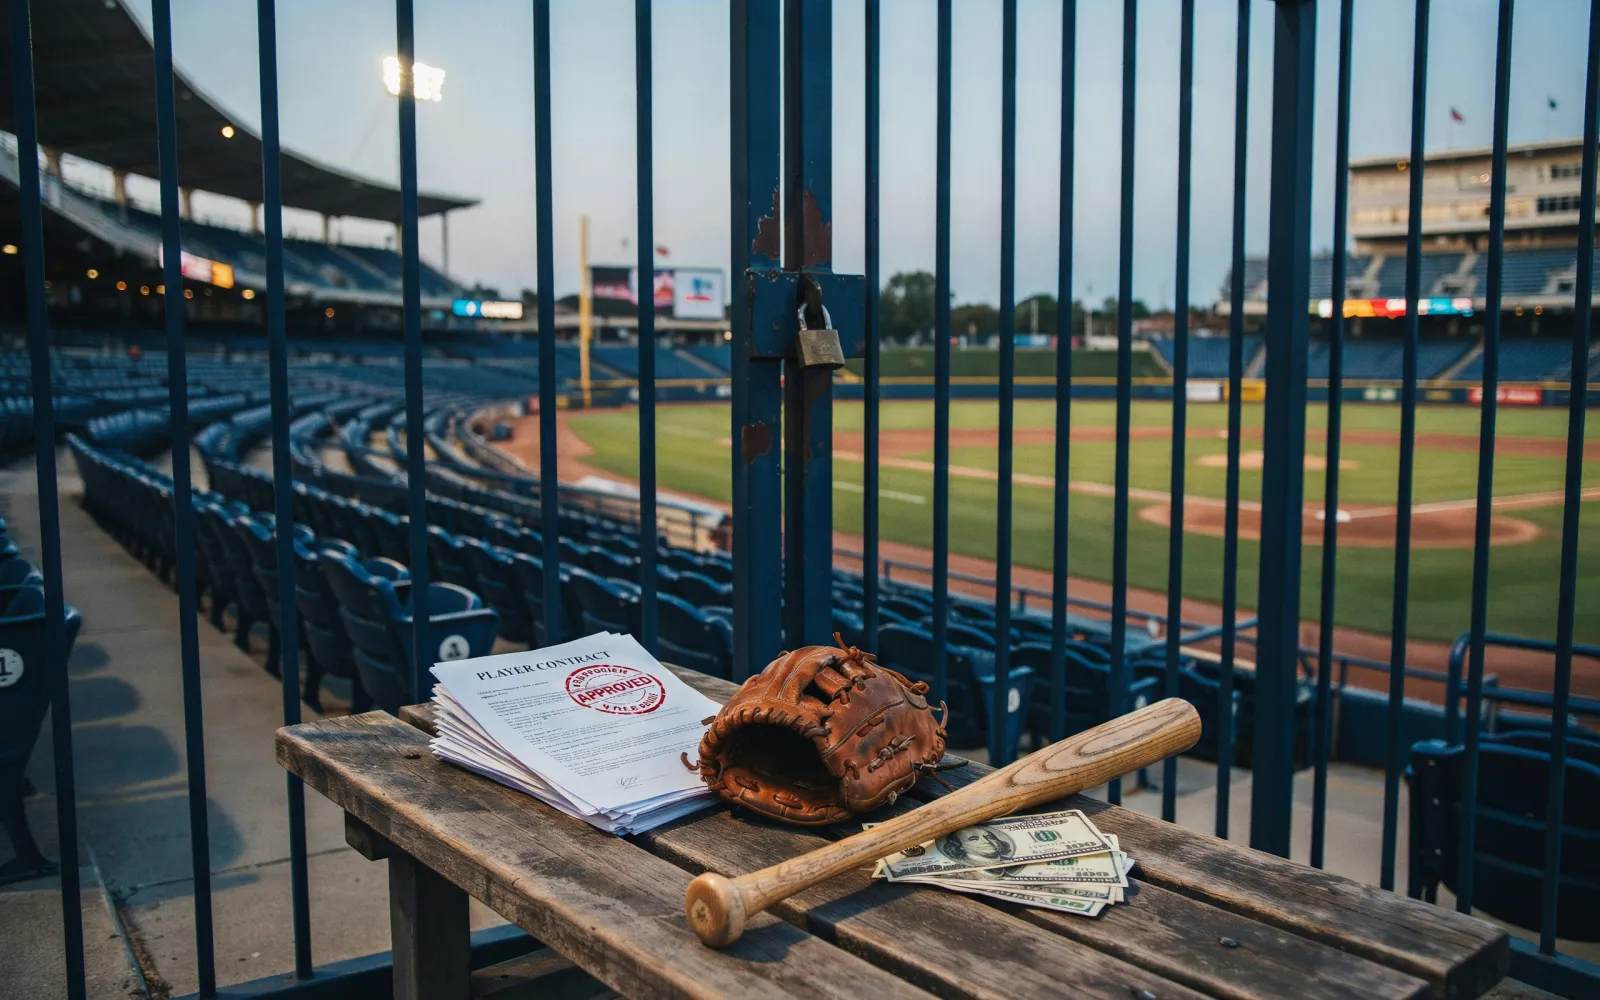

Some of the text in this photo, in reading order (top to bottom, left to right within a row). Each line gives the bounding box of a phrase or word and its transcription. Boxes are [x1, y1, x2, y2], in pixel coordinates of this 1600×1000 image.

[0, 657, 13, 676] 1
[475, 650, 611, 681] PLAYER CONTRACT
[577, 676, 653, 703] APPROVED
